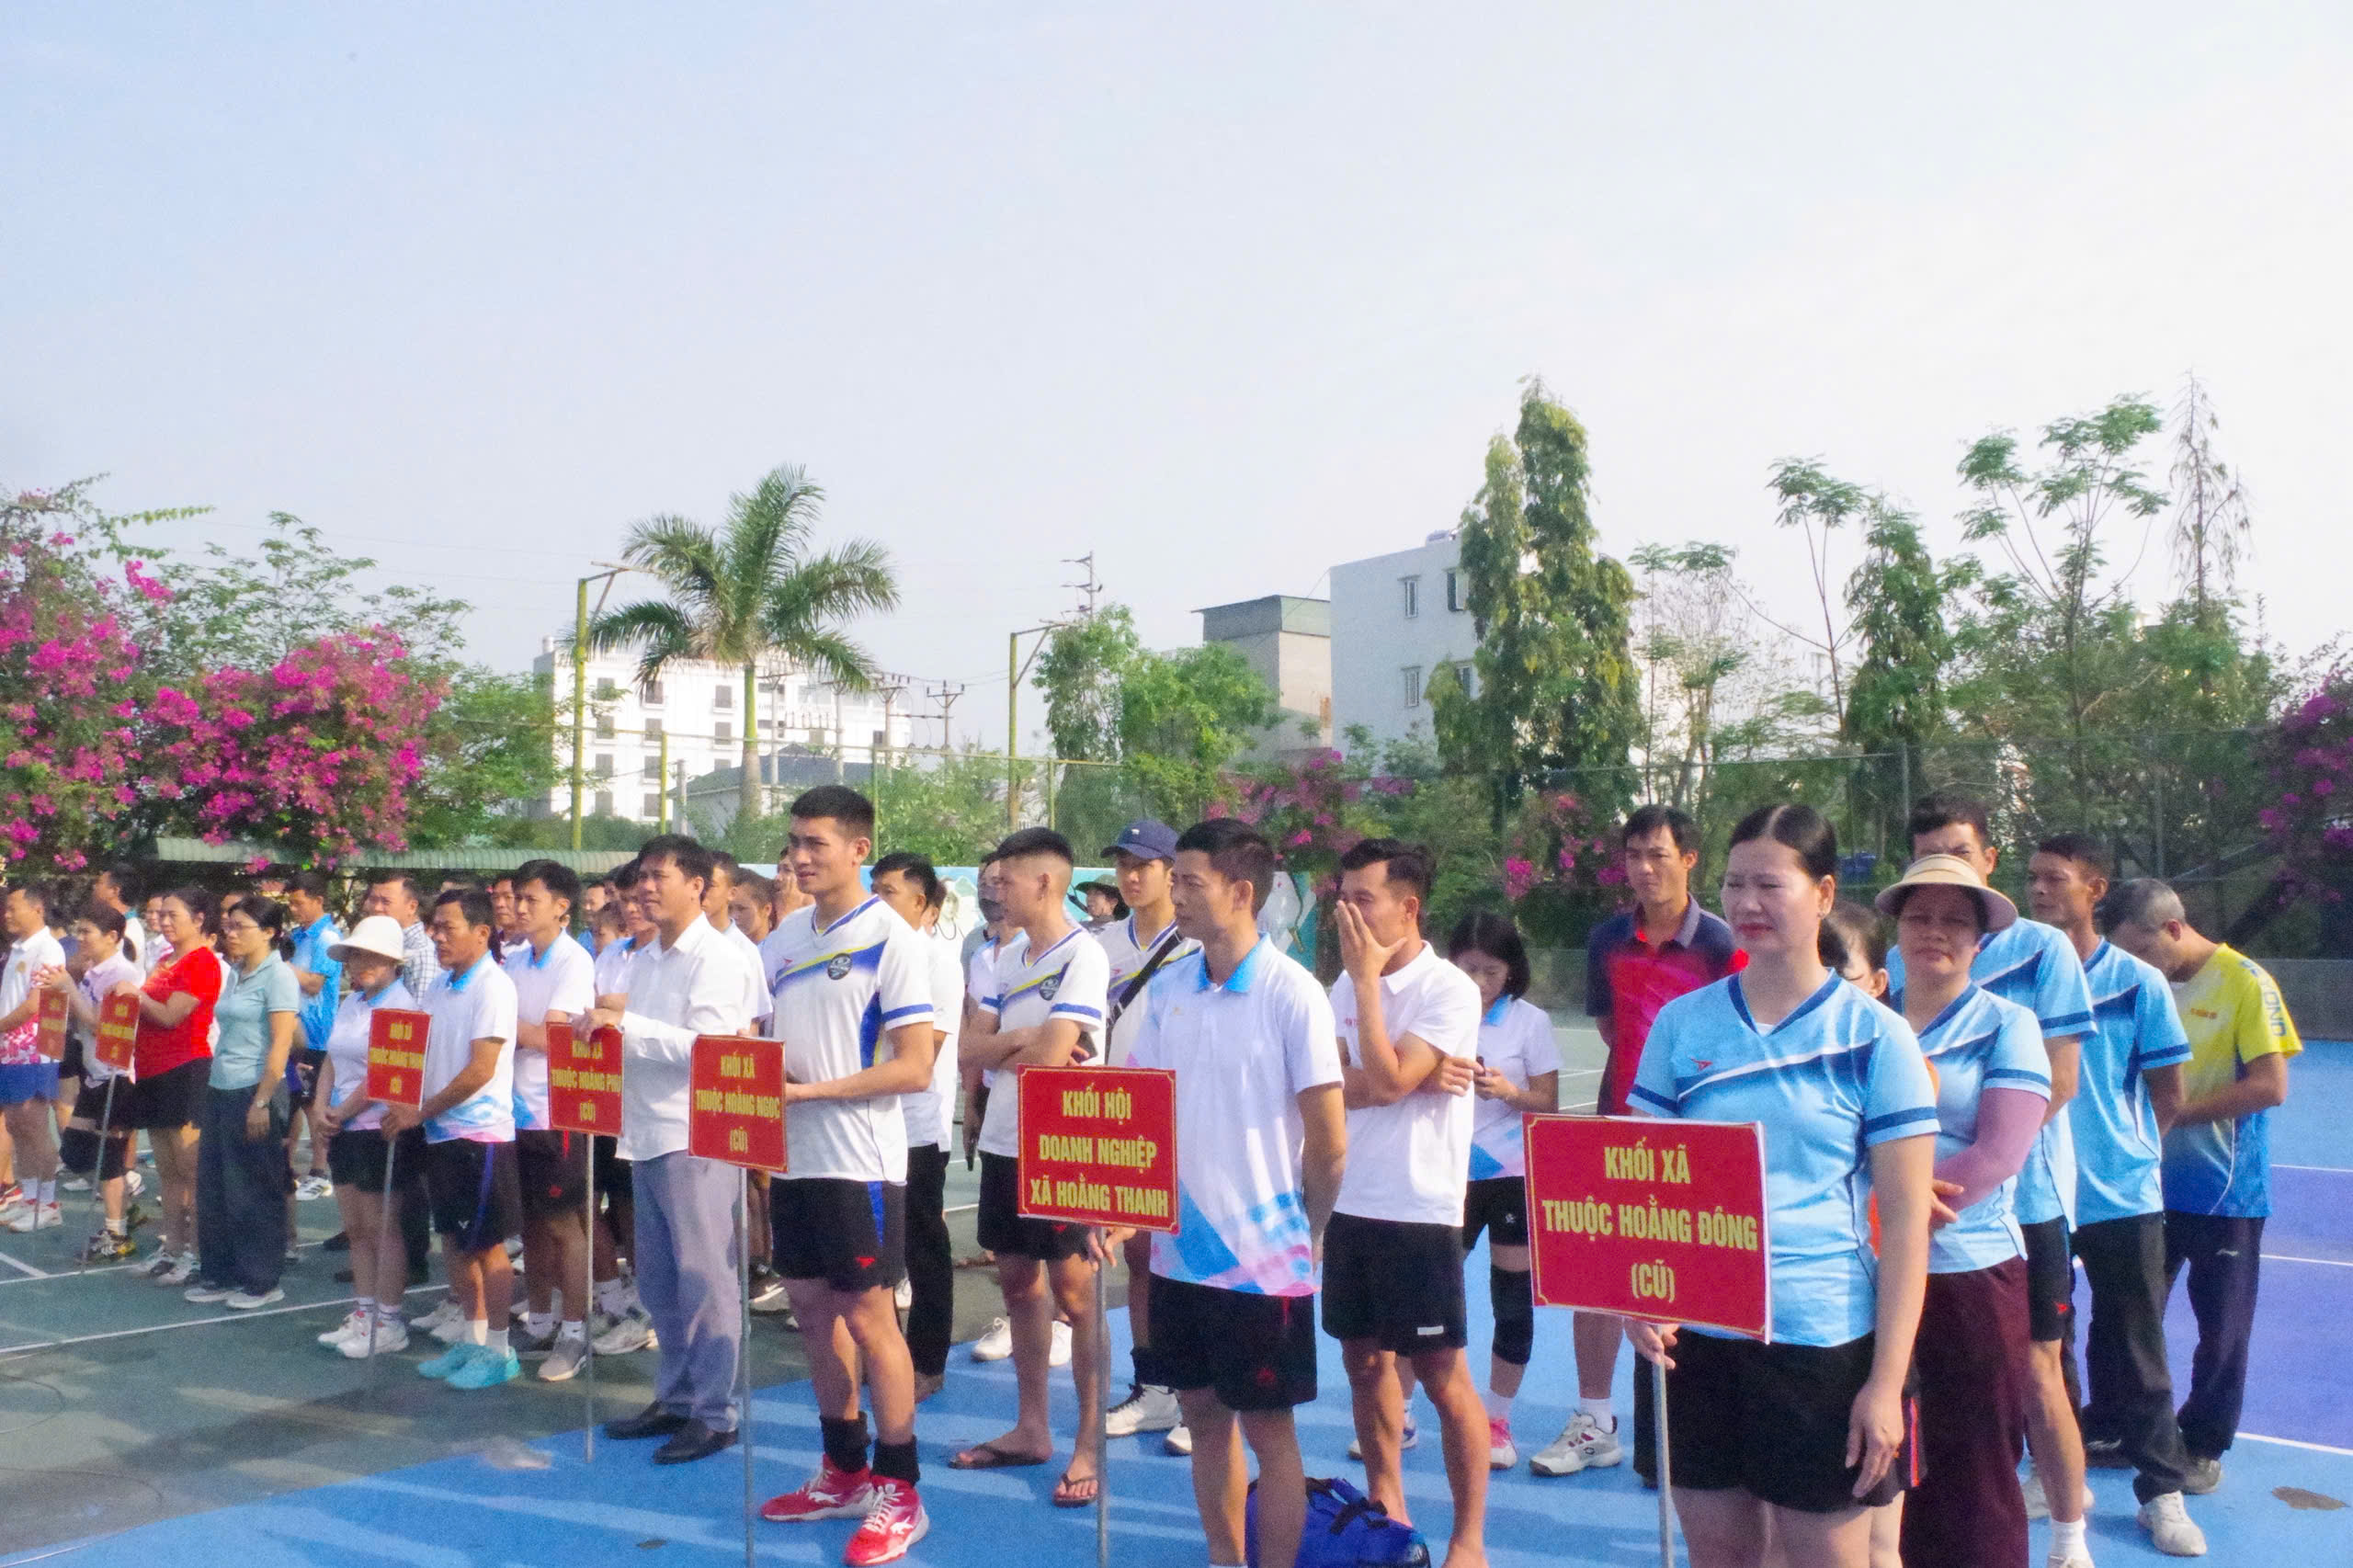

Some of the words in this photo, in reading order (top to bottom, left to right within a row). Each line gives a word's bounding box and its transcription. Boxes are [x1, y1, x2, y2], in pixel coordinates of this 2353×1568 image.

[721, 1051, 741, 1078] KHỐI
[743, 1052, 756, 1079] XÃ
[696, 1086, 722, 1117] THUỘC
[724, 1085, 756, 1116] HOẰNG
[756, 1096, 780, 1124] NGỌC
[1063, 1082, 1100, 1119] KHỐI
[1105, 1086, 1131, 1126] HỘI
[730, 1125, 748, 1154] (CŨ)
[1040, 1134, 1093, 1164] DOANH
[1097, 1134, 1157, 1175] NGHIỆP
[1604, 1136, 1655, 1181] KHỐI
[1662, 1143, 1691, 1184] XÃ
[1030, 1175, 1052, 1206] XÃ
[1056, 1172, 1111, 1212] HOẰNG
[1115, 1186, 1168, 1217] THANH
[1541, 1195, 1612, 1242] THUỘC
[1618, 1193, 1692, 1243] HOẰNG
[1698, 1205, 1758, 1251] ĐÔNG
[1631, 1259, 1676, 1303] (CŨ)
